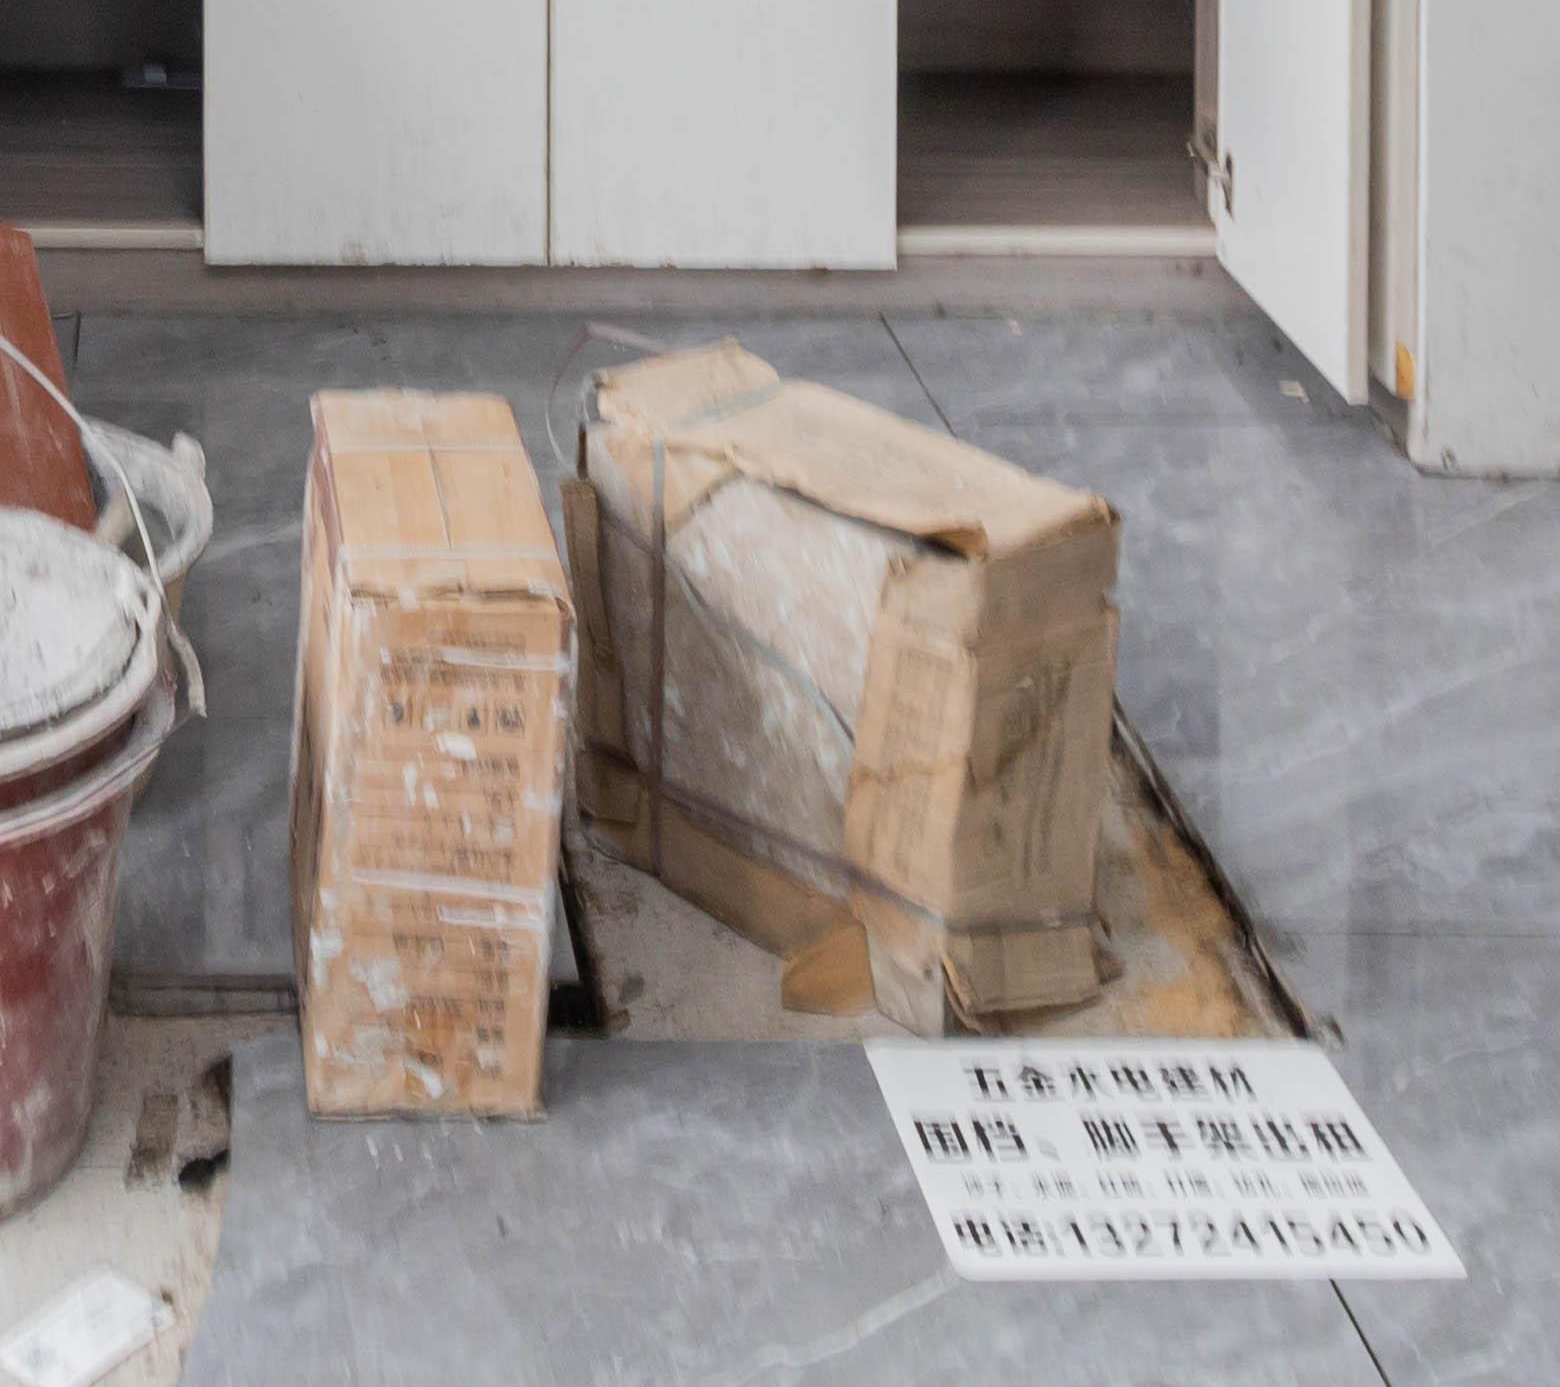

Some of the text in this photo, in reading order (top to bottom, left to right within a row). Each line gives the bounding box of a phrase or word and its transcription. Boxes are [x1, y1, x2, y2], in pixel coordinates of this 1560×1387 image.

[964, 1056, 1260, 1103] 五金水电建材
